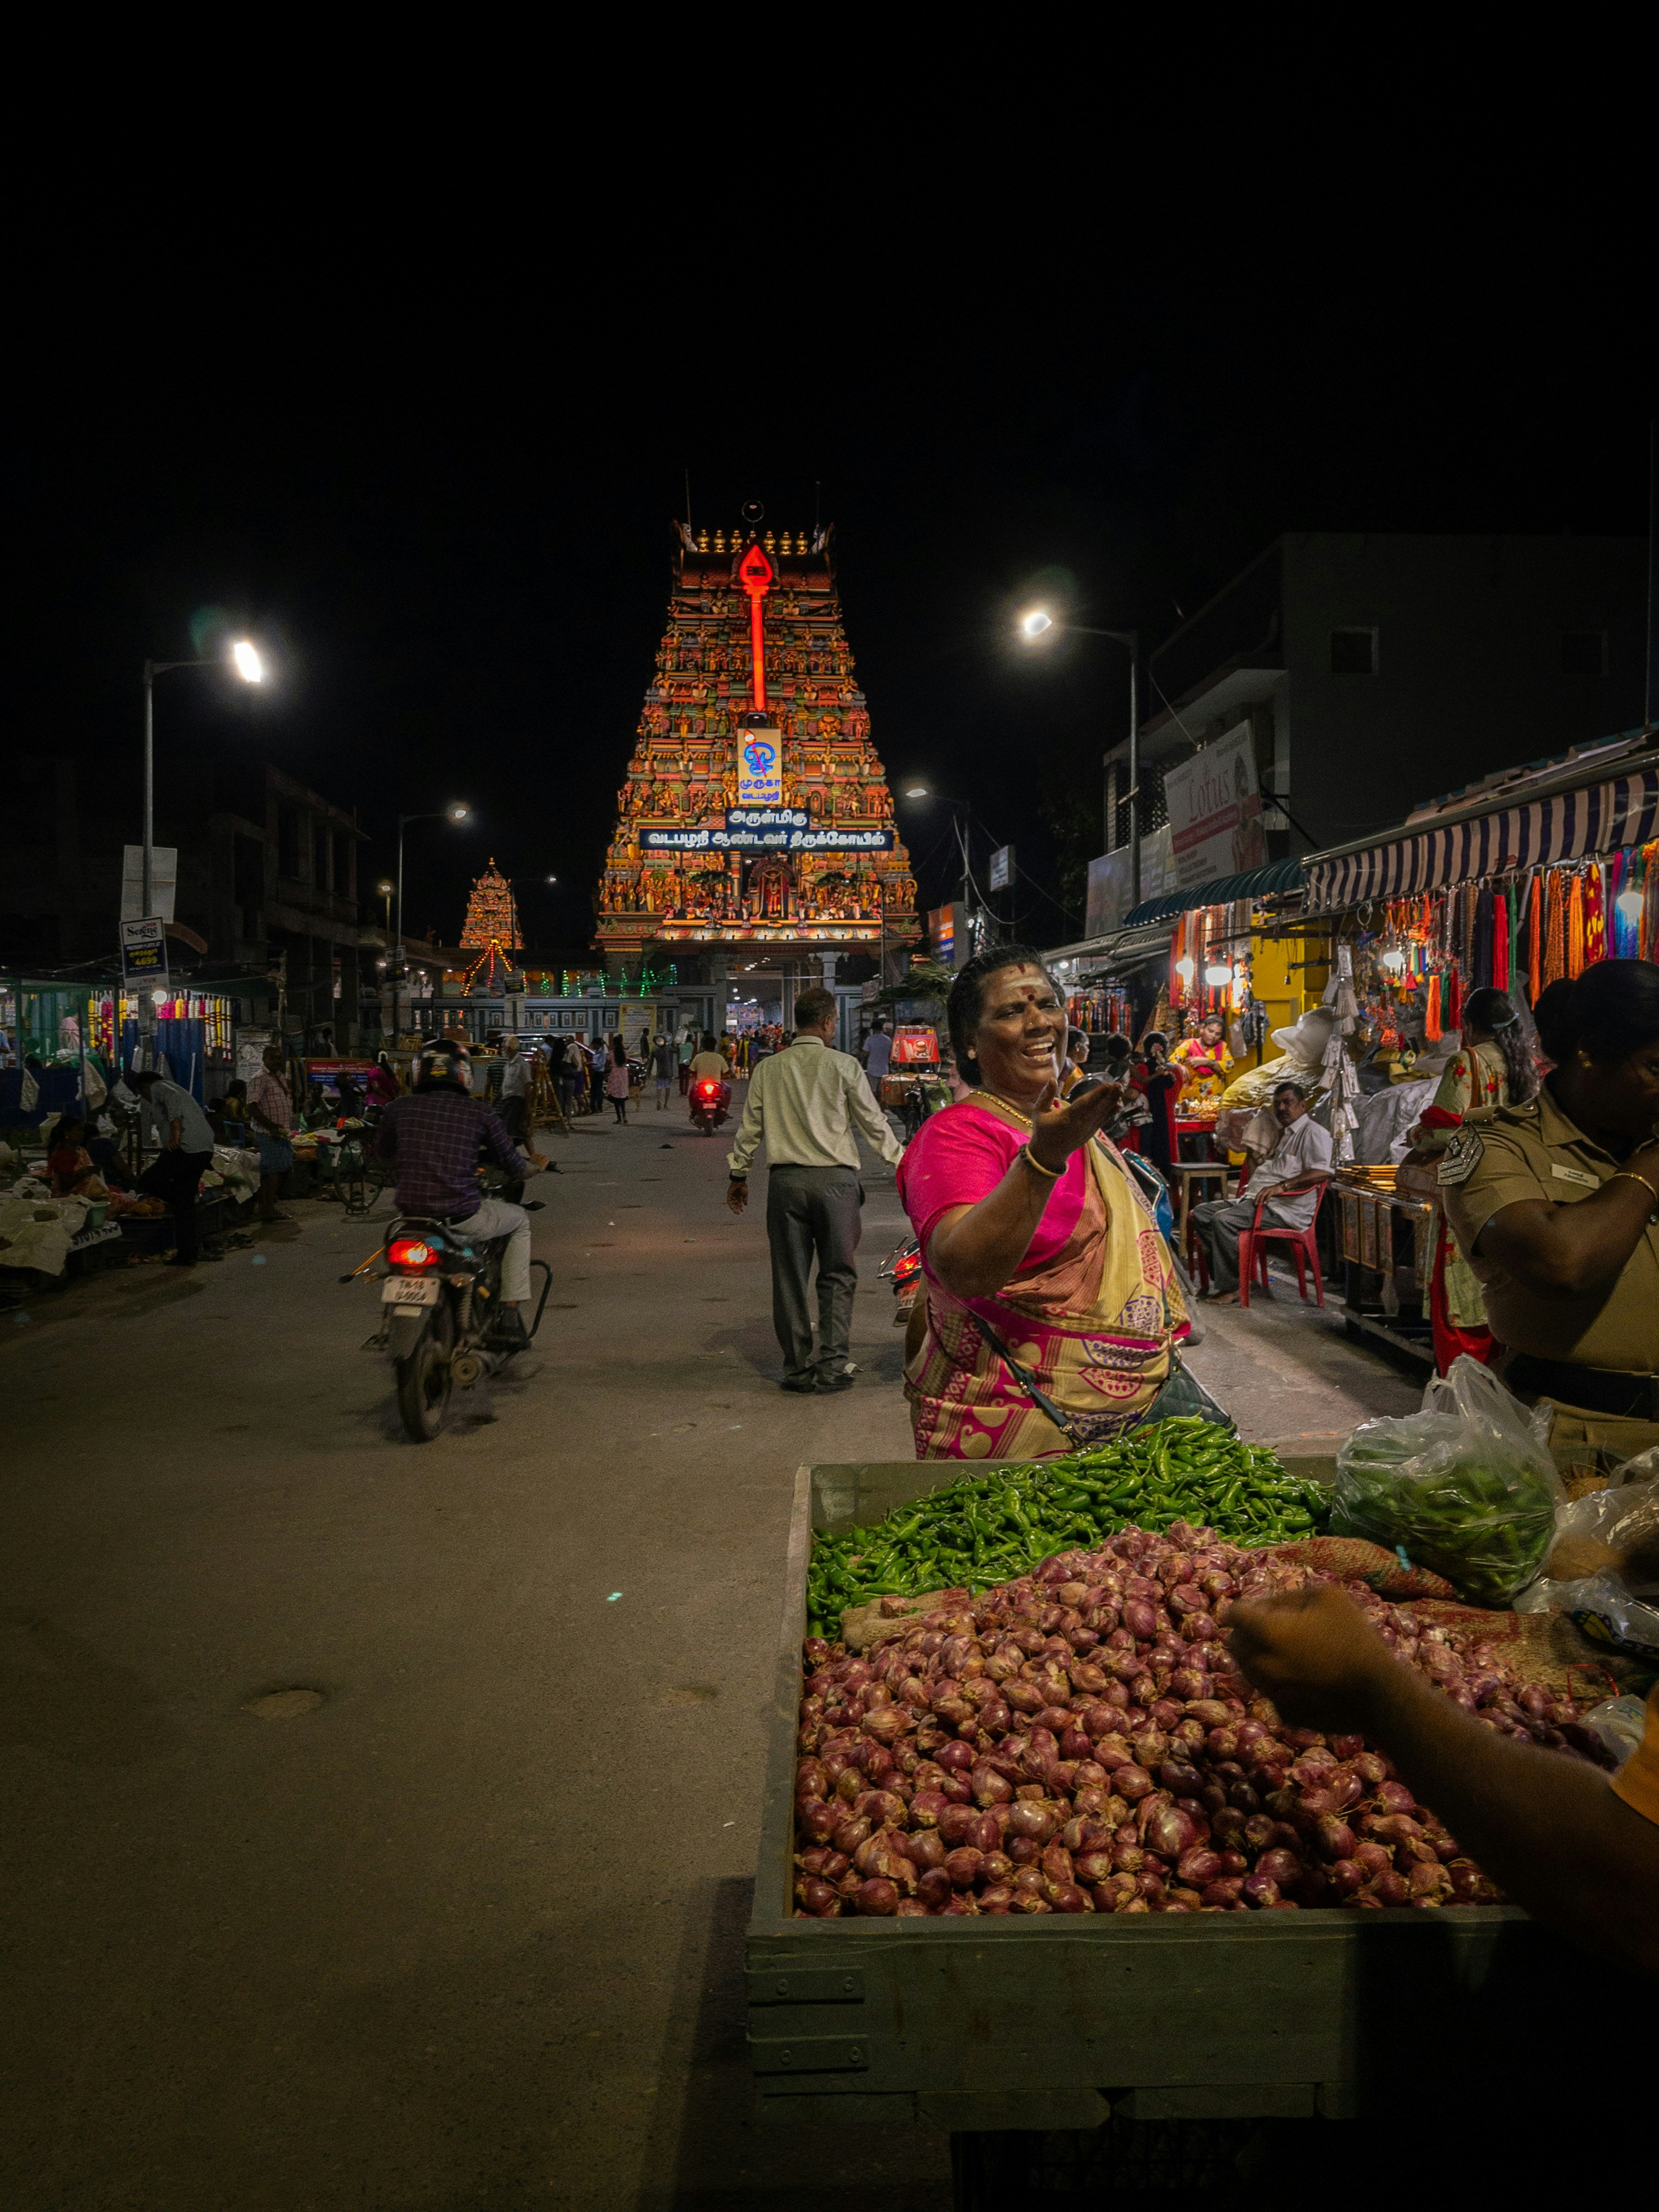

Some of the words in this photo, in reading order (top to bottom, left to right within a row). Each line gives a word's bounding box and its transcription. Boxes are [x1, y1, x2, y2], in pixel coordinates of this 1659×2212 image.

[729, 809, 807, 827] அருள்மிகு
[713, 831, 788, 847] ஆண்டவர்
[789, 831, 885, 848] திருக்கோயில்
